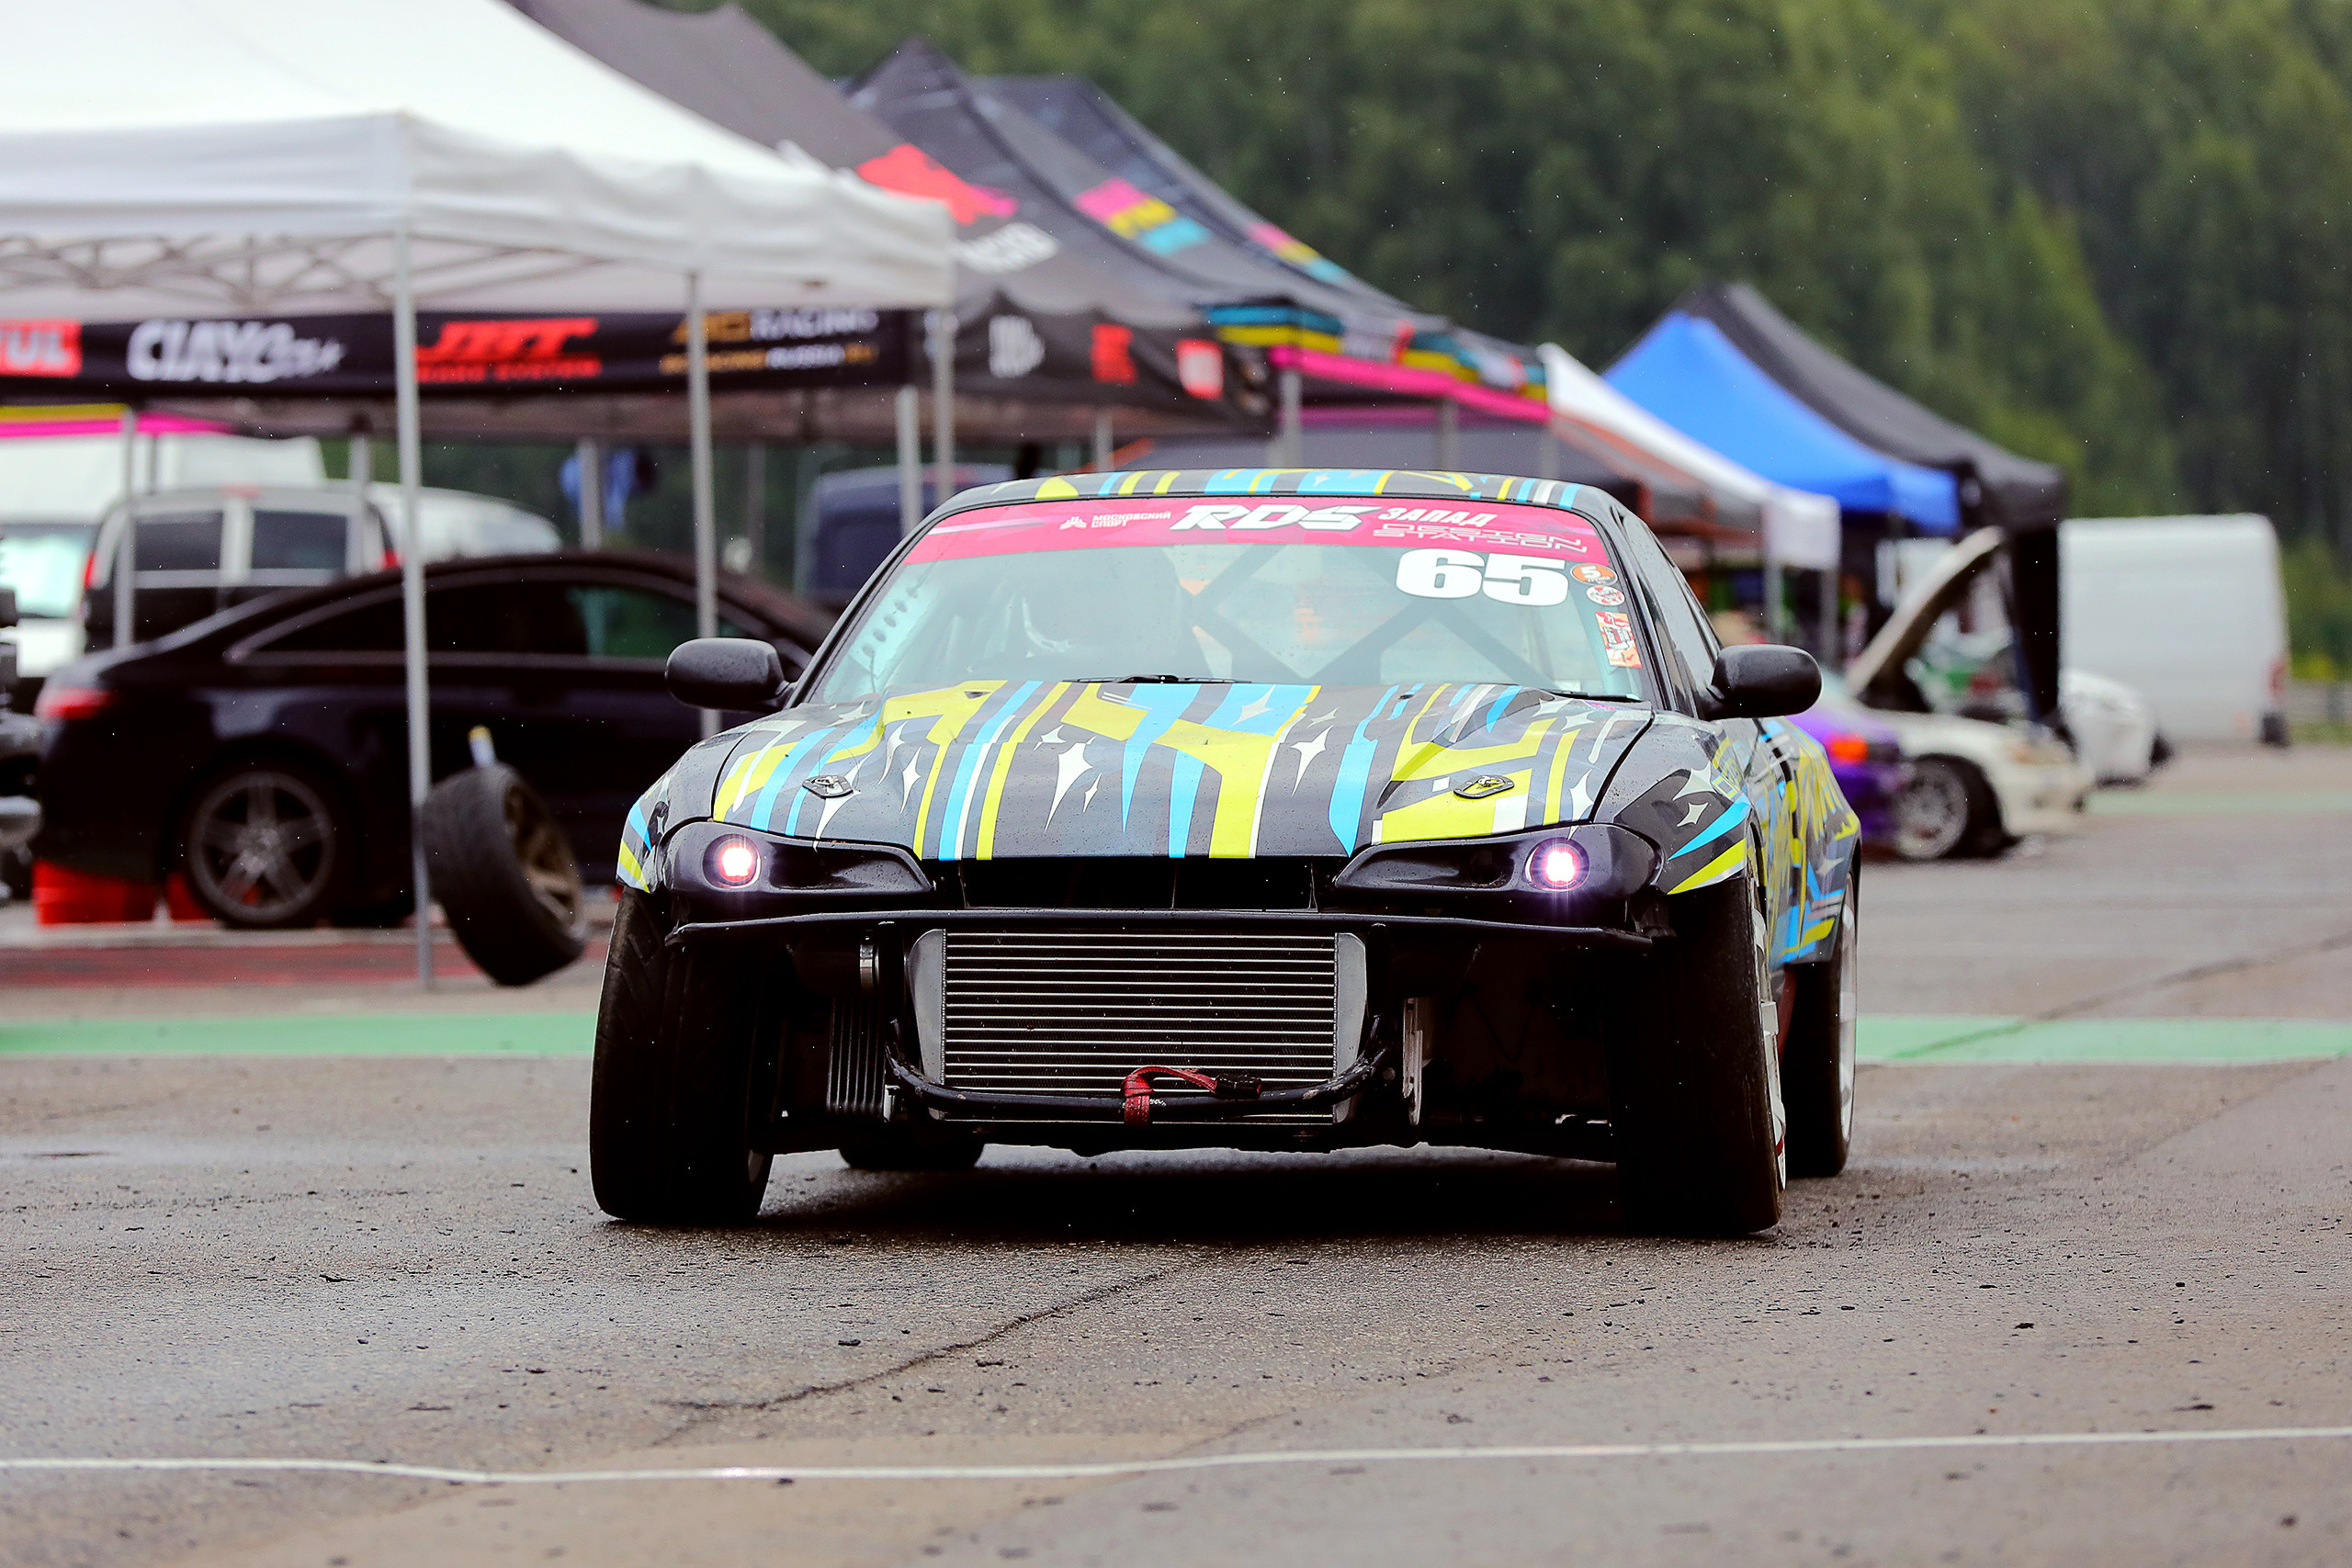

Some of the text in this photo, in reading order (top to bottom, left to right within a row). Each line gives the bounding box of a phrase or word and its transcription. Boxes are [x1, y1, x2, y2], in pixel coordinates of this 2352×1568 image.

[1091, 511, 1171, 522] МОСКОВСКИЙ
[1091, 519, 1127, 528] СПОРТ
[1169, 504, 1382, 531] RDS
[1378, 507, 1498, 527] ЗАПАД
[1374, 528, 1588, 553] STATION
[1396, 548, 1569, 606] 65
[1580, 565, 1601, 579] 5
